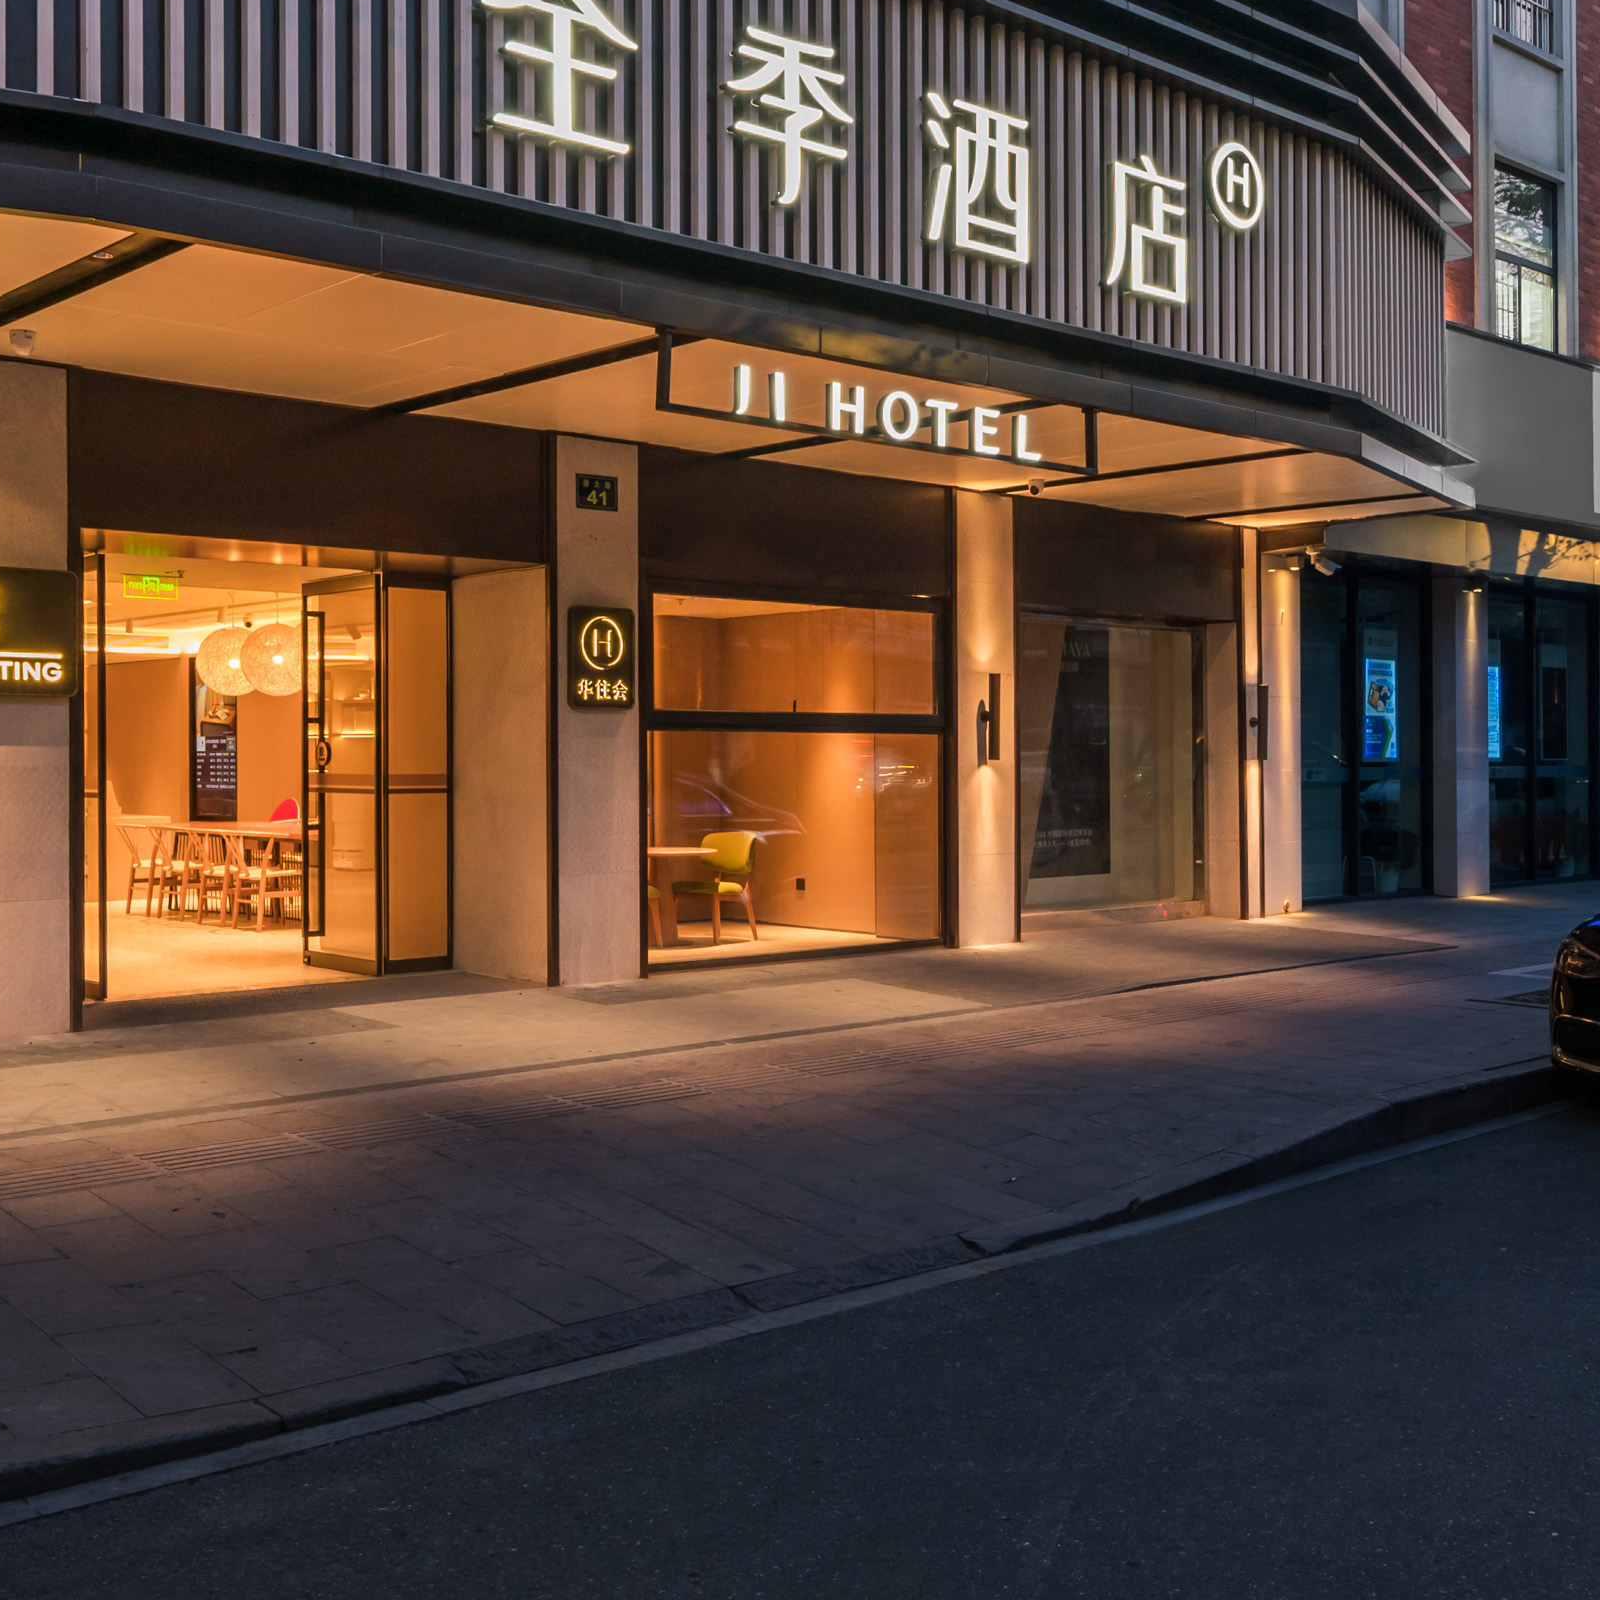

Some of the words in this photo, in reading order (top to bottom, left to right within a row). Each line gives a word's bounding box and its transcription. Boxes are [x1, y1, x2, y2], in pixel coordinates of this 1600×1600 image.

[734, 364, 787, 422] JI
[830, 381, 1043, 462] HOTEL
[586, 489, 607, 506] 41
[578, 679, 629, 702] 华住会
